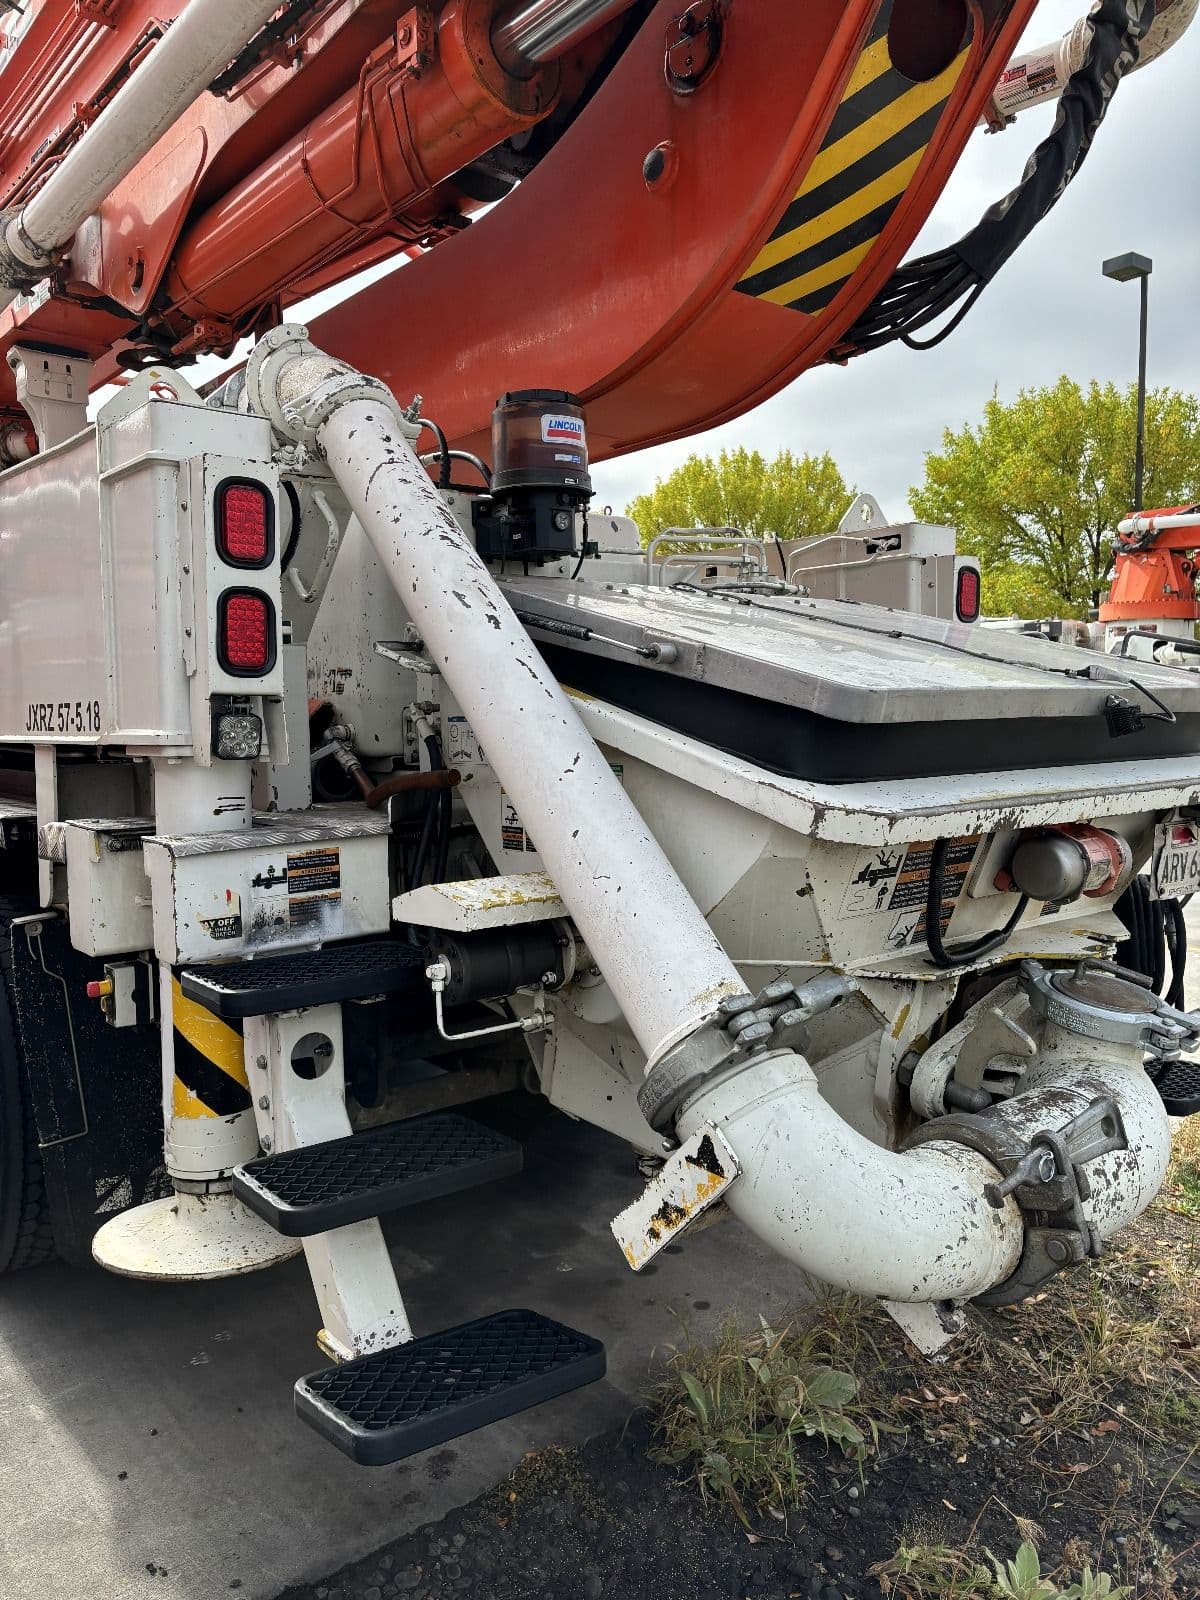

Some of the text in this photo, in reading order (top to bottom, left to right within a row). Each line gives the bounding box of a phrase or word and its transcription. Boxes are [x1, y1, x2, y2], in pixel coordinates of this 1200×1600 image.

[549, 420, 582, 433] LINCOLN
[26, 700, 101, 733] JXRZ 57-5.18
[1161, 852, 1189, 884] ARV
[217, 918, 235, 927] OFF
